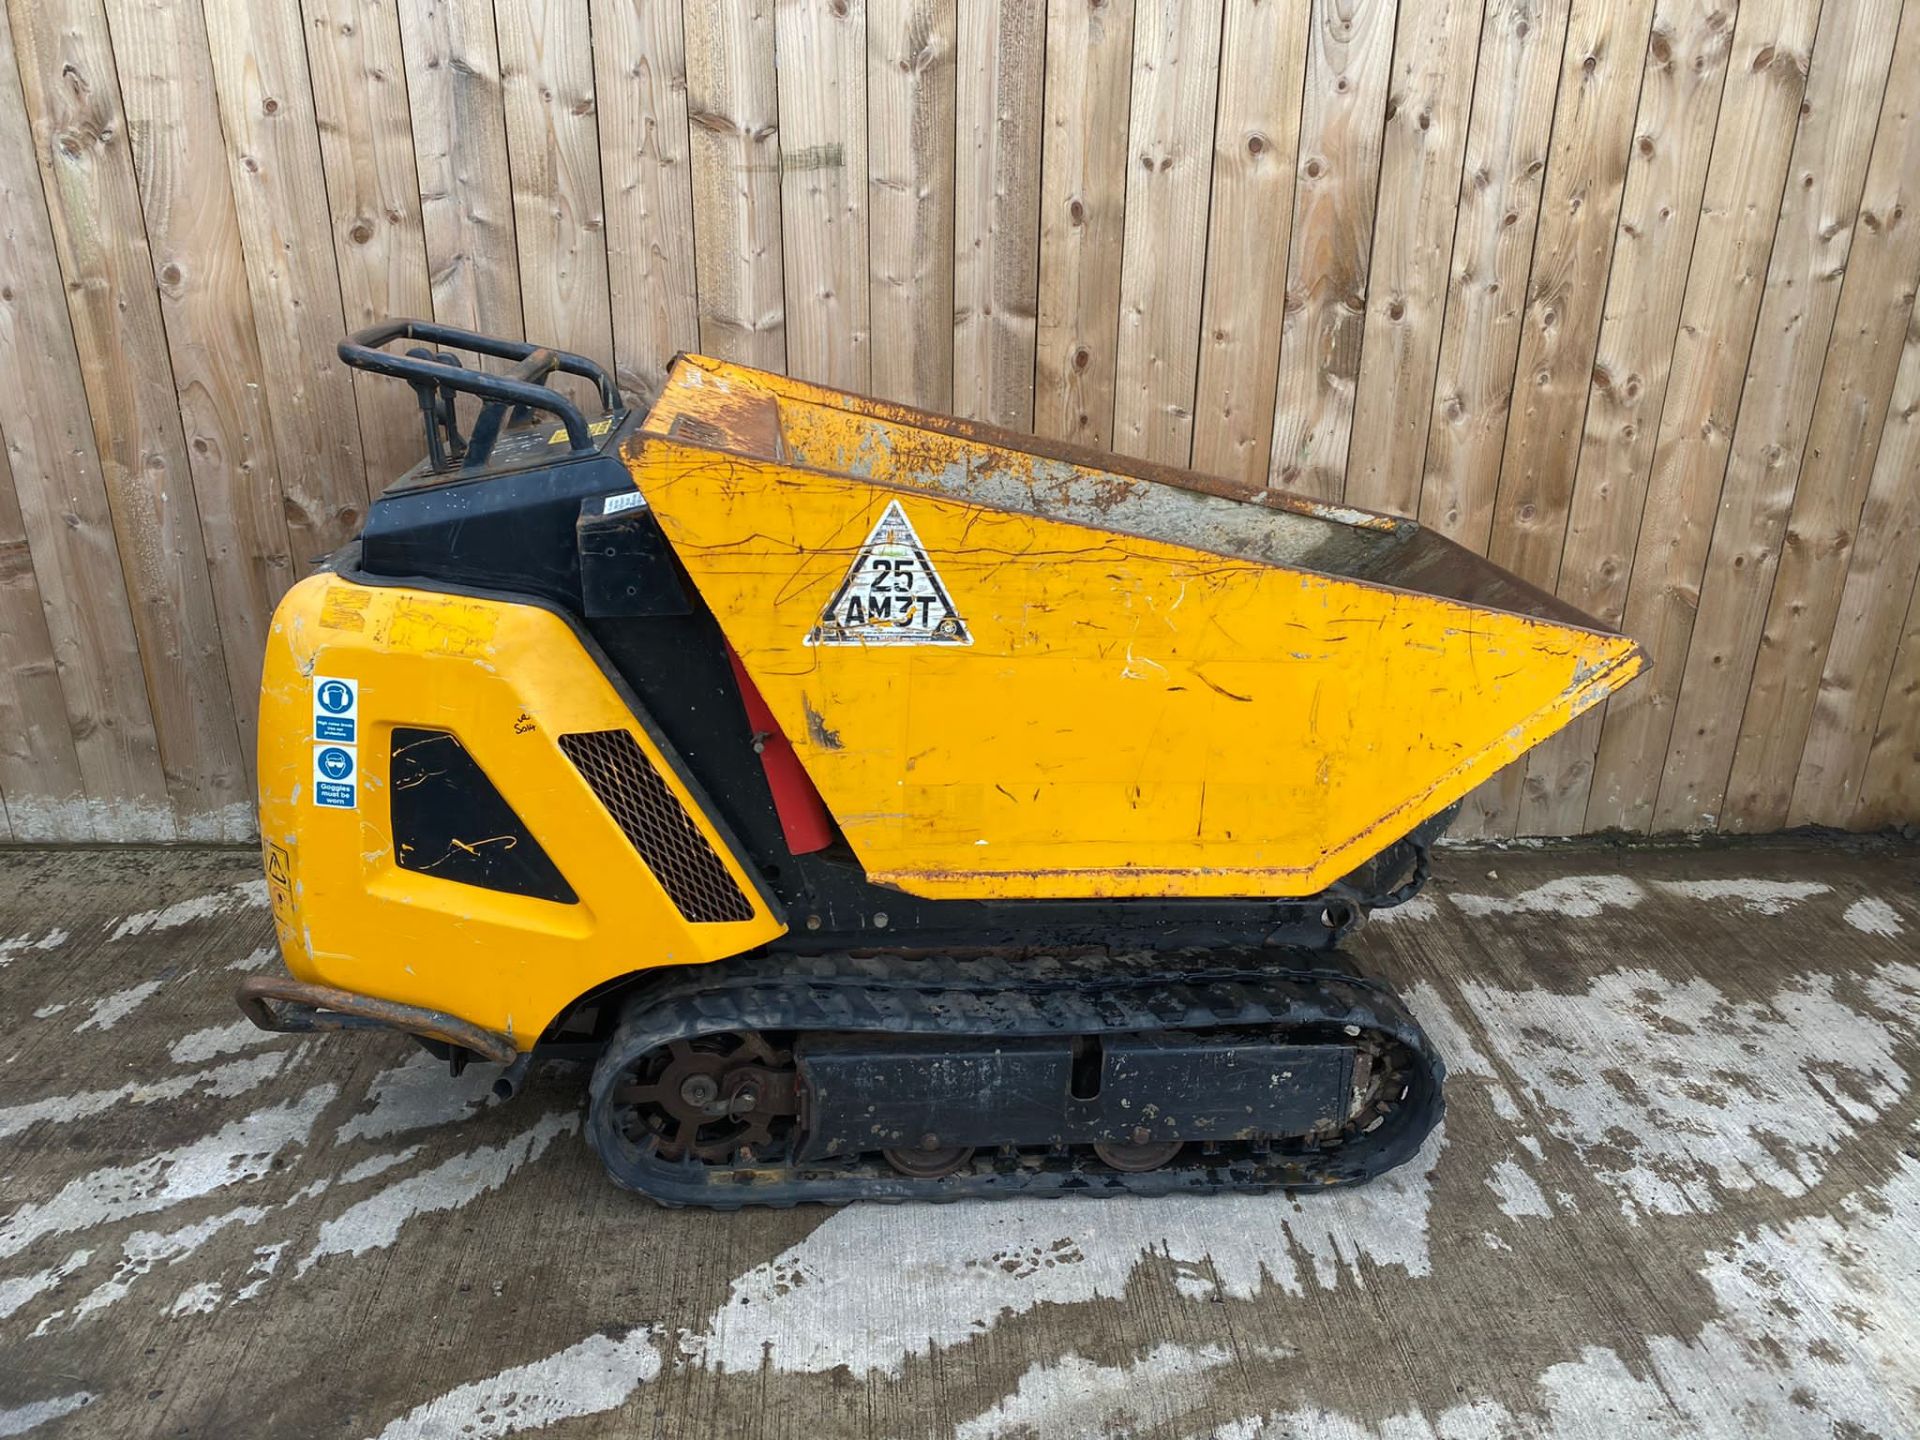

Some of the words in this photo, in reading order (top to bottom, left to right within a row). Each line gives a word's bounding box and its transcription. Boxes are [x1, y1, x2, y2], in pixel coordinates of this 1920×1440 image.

[870, 559, 914, 593] 25
[844, 595, 937, 628] AM3T
[320, 784, 350, 792] Goggles
[321, 790, 340, 798] must
[340, 791, 350, 799] be
